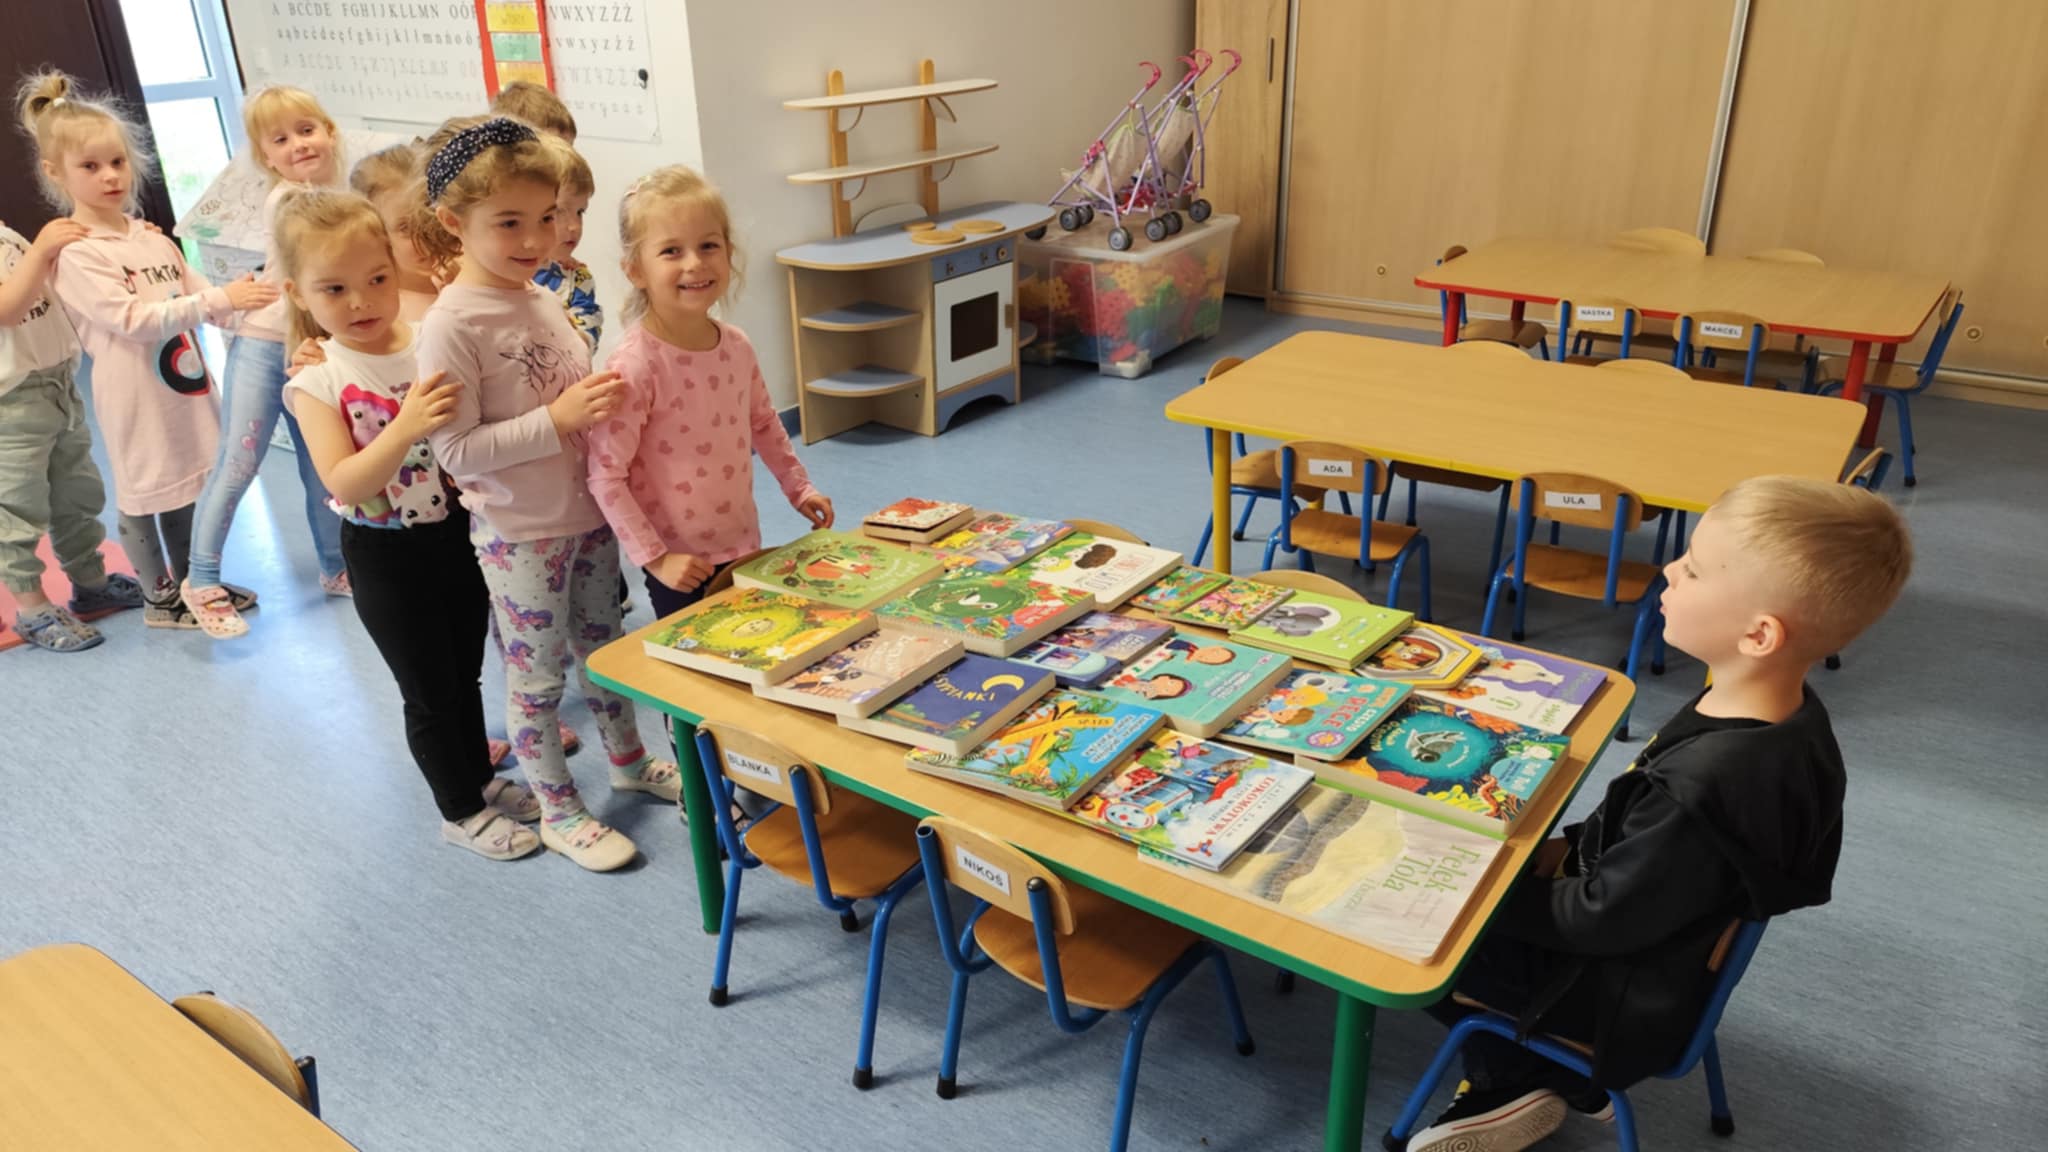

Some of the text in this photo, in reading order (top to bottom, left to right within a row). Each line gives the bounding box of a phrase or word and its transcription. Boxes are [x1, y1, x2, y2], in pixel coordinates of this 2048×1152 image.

[1703, 325, 1741, 337] MARCEL
[1323, 464, 1344, 474] ADA
[1563, 495, 1586, 506] ULA
[727, 752, 772, 778] BLANKA
[1203, 775, 1277, 837] LOKOMOTYWA
[1380, 852, 1438, 893] Tola
[1420, 845, 1481, 894] Felek
